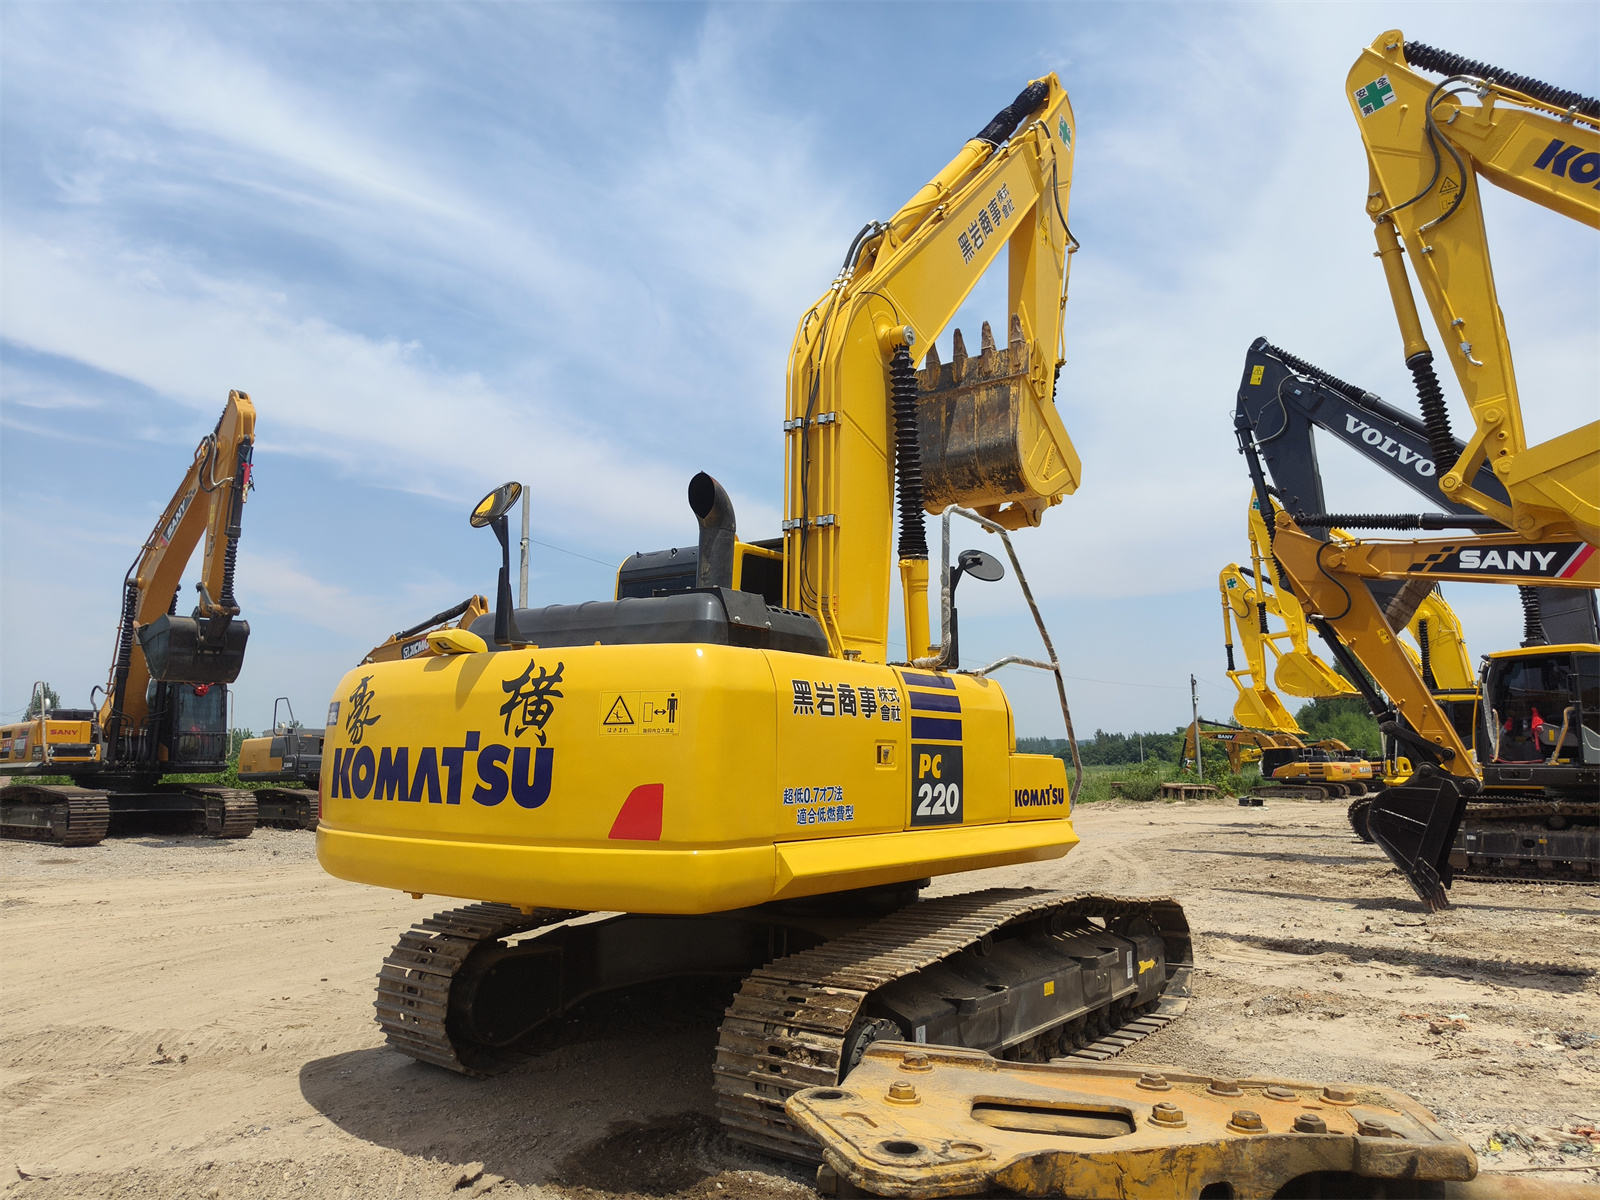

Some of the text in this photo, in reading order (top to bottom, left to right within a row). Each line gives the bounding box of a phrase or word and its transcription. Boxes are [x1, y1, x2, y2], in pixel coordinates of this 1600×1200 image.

[1532, 137, 1600, 192] KO
[1345, 413, 1437, 477] VOLVO
[167, 499, 185, 540] SANY
[1459, 550, 1557, 571] SANY
[877, 686, 900, 703] 株式
[331, 731, 554, 809] KOMATSU
[918, 753, 942, 779] PC
[916, 782, 960, 816] 220
[1014, 783, 1065, 808] KOMATSU
